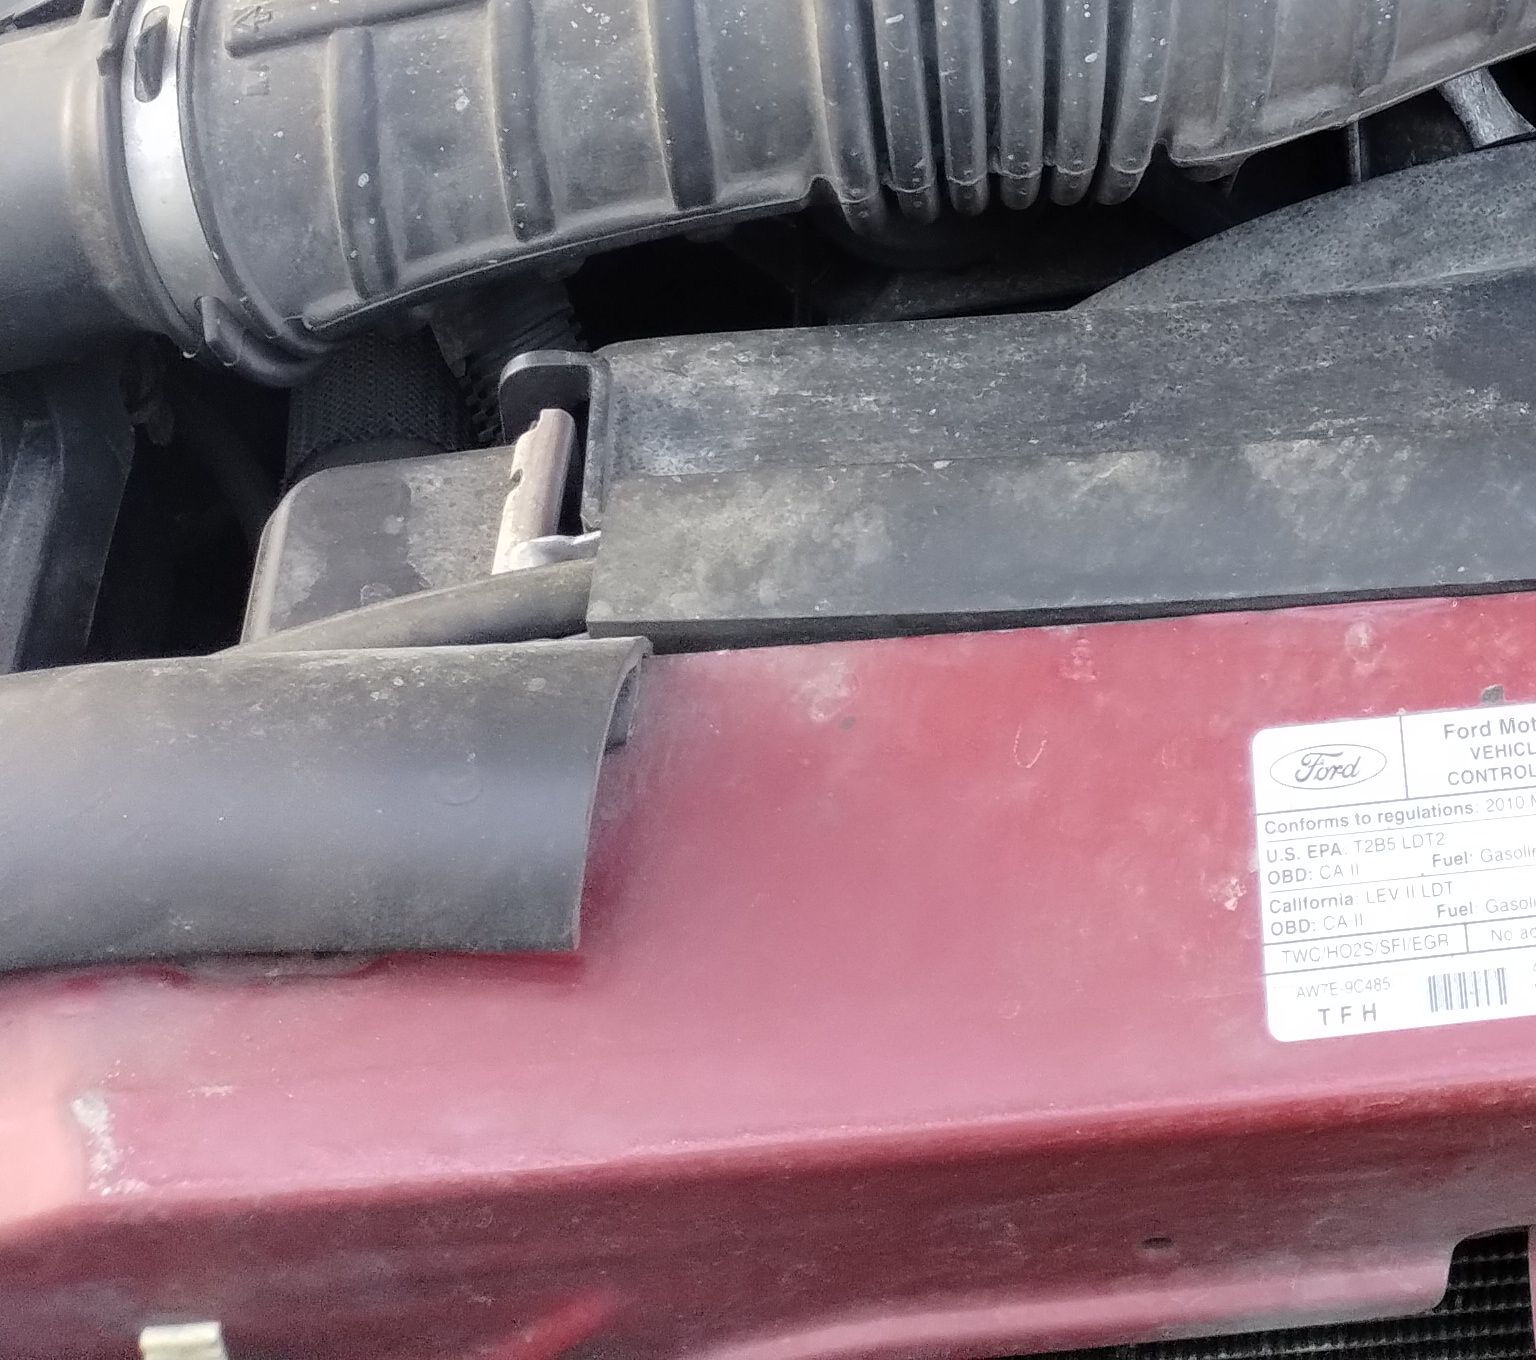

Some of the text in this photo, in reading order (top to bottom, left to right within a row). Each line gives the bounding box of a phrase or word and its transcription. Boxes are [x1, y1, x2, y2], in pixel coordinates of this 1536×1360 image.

[1443, 719, 1492, 740] Ford
[1293, 750, 1362, 783] Ford
[1264, 814, 1349, 835] Conforms
[1354, 812, 1372, 826] to
[1485, 795, 1525, 812] 2010
[1267, 867, 1312, 885] OBD:
[1319, 864, 1344, 880] CA
[1365, 887, 1398, 904] LEV
[1405, 884, 1414, 899] II
[1421, 880, 1453, 898] LDT
[1270, 918, 1316, 936] OBD:
[1323, 914, 1348, 930] CA
[1490, 927, 1512, 942] No
[1317, 1002, 1377, 1026] T F H
